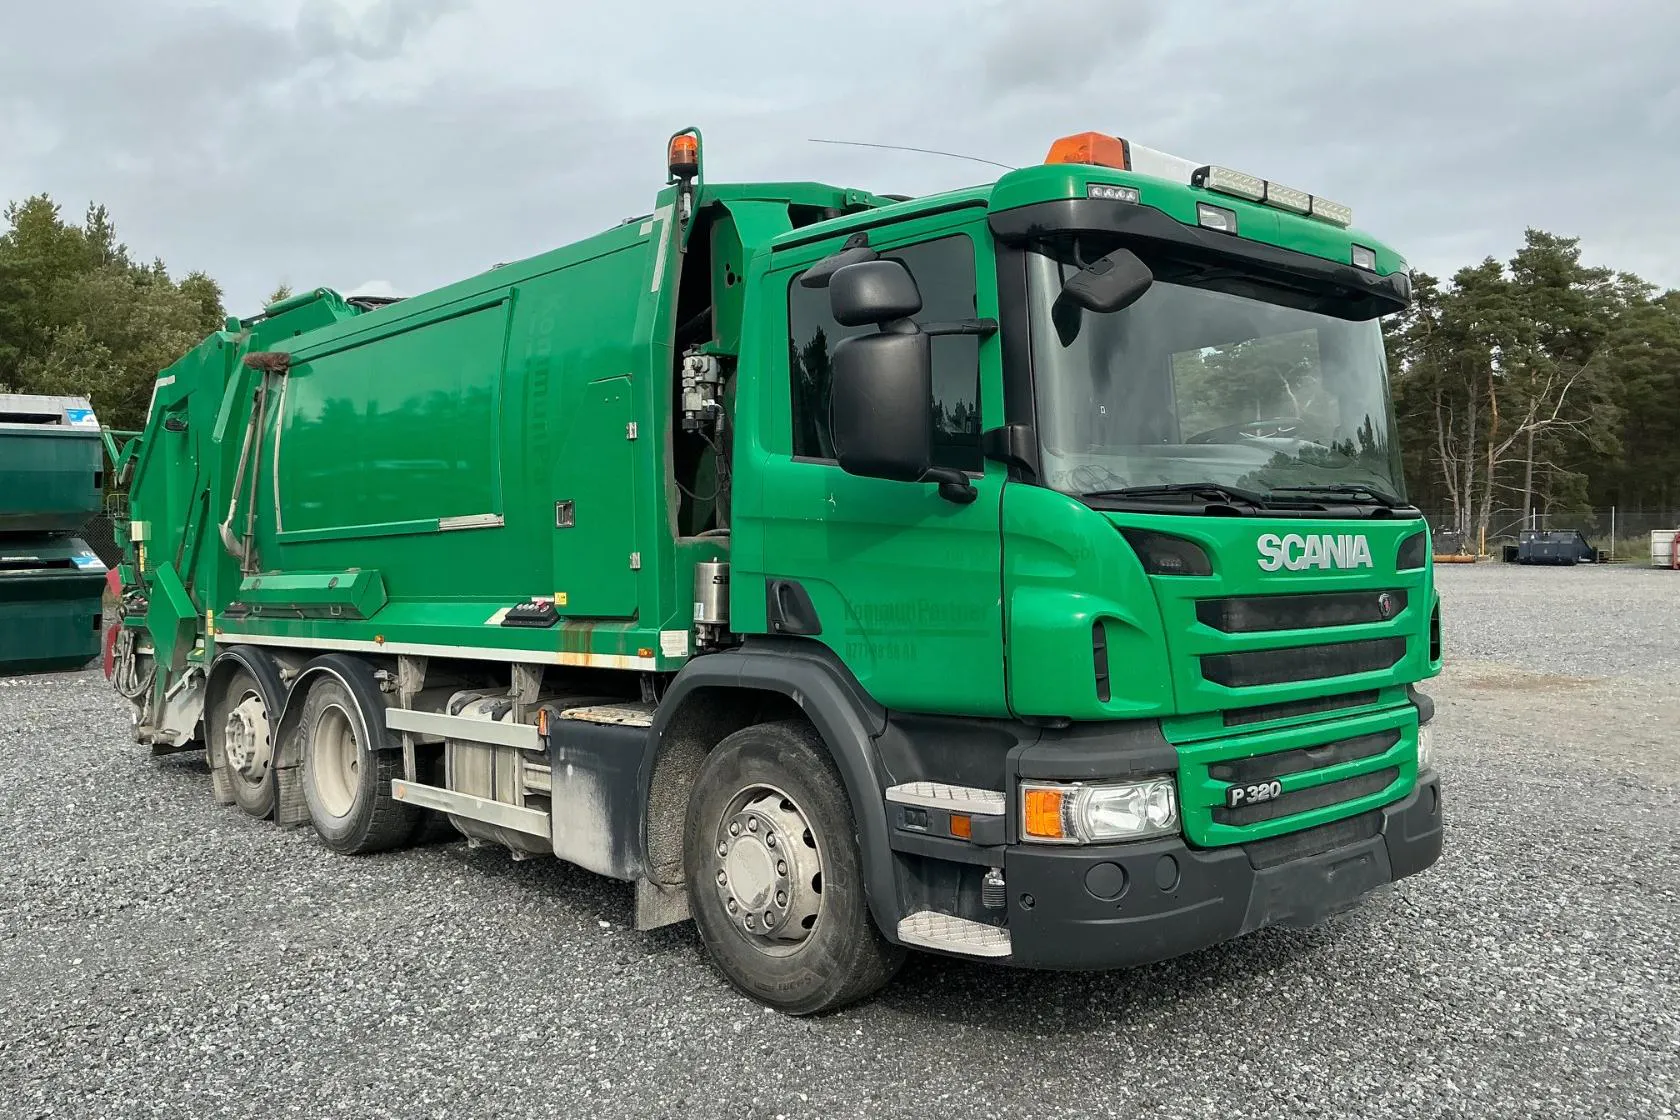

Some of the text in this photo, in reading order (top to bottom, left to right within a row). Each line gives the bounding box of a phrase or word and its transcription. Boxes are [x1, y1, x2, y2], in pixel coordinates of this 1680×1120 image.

[1257, 533, 1373, 571] SCANIA
[1232, 781, 1281, 806] P 320
